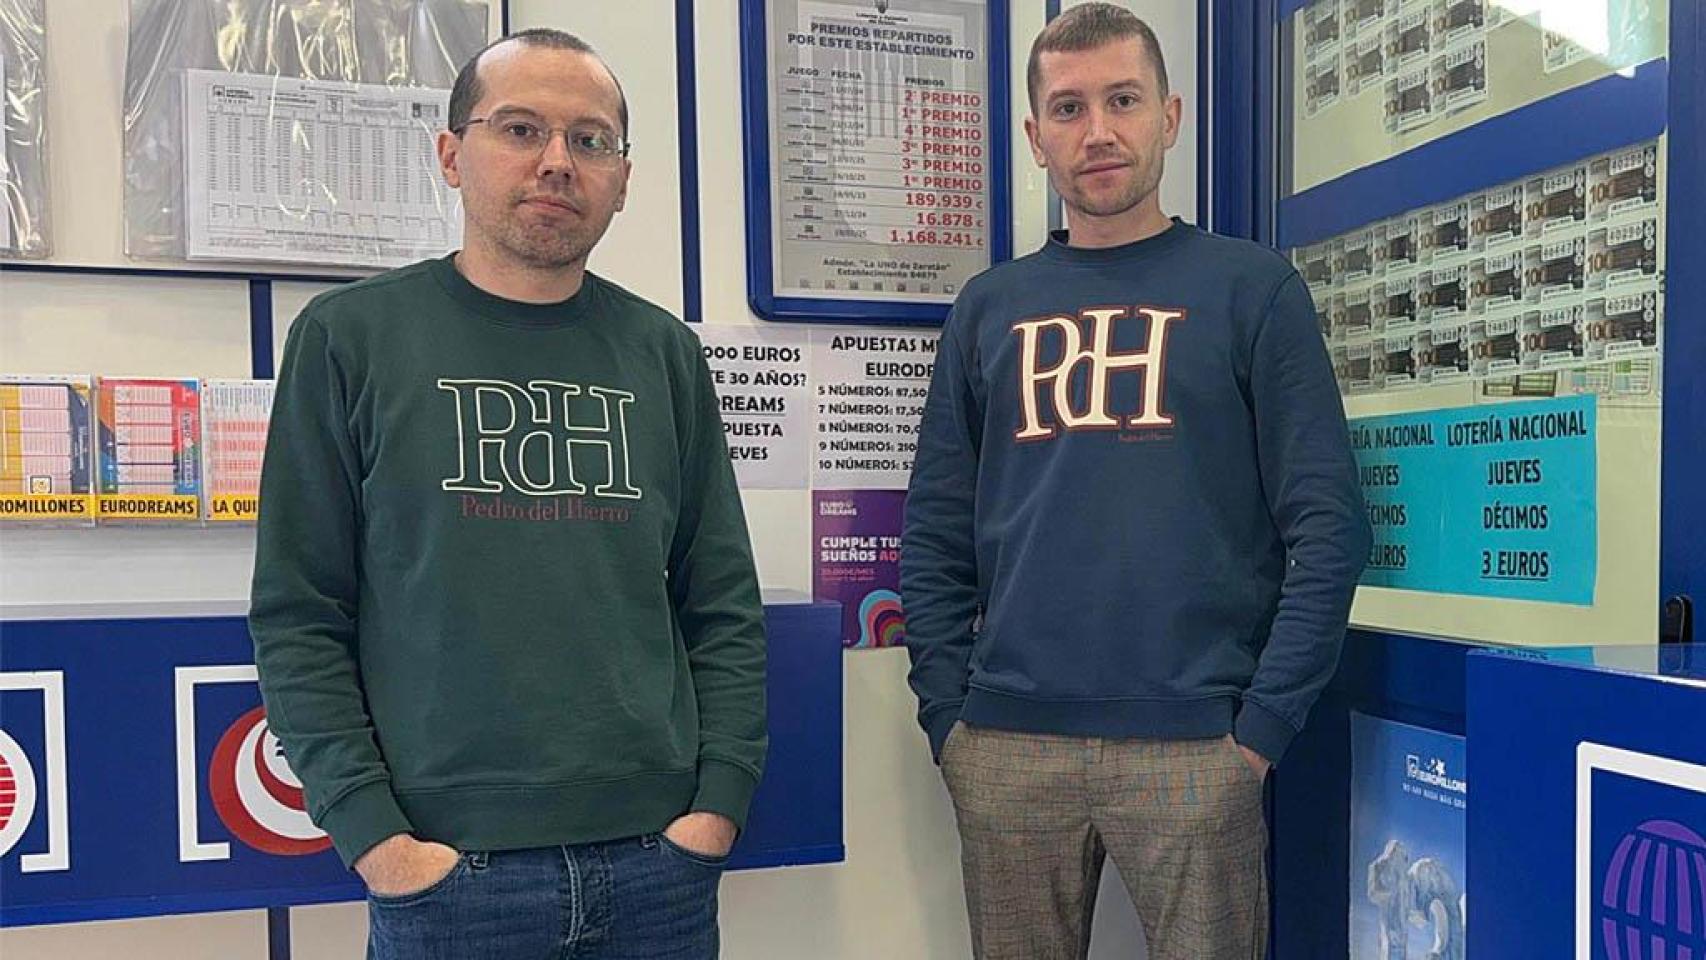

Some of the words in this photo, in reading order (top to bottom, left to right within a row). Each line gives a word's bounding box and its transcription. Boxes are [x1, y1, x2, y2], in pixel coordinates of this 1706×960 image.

[810, 22, 869, 38] PREMIOS
[872, 29, 953, 45] REPARTIDOS
[787, 33, 816, 46] POR
[819, 37, 852, 49] ESTE
[856, 40, 974, 60] ESTABLECIMIENTO
[787, 67, 819, 76] JUEGO
[831, 70, 862, 80] FECHA
[905, 78, 945, 87] PREMIOS
[922, 91, 981, 107] PREMIO
[922, 108, 981, 124] PREMIO
[922, 126, 982, 141] PREMIO
[922, 142, 982, 158] PREMIO
[923, 160, 983, 174] PREMIO
[923, 176, 983, 190] PREMIO
[906, 192, 972, 208] 189.939
[917, 212, 973, 227] 16.878
[890, 229, 972, 245] 1.168.241
[831, 335, 917, 352] APUESTAS
[743, 346, 801, 362] EUROS
[729, 372, 749, 385] 30
[753, 369, 807, 387] AÑOS?
[817, 386, 825, 396] 5
[828, 382, 894, 397] NÚMEROS:
[722, 395, 785, 413] REAMS
[817, 404, 826, 414] 7
[828, 401, 894, 415] NÚMEROS:
[818, 423, 826, 432] 8
[829, 420, 894, 434] NÚMEROS:
[1375, 422, 1435, 448] NACIONAL
[1447, 414, 1504, 447] LOTERÍA
[1509, 410, 1588, 442] NACIONAL
[437, 378, 643, 499] PdH
[818, 441, 827, 451] 9
[830, 437, 895, 452] NÚMEROS:
[730, 446, 769, 460] EVES
[819, 459, 832, 469] 10
[835, 456, 900, 471] NÚMEROS:
[1360, 464, 1400, 486] JUEVES
[1487, 459, 1542, 486] JUEVES
[101, 500, 194, 515] EURODREAMS
[213, 500, 229, 513] LA
[233, 500, 257, 516] QUI
[460, 494, 525, 518] Pedro
[530, 497, 560, 521] del
[567, 496, 630, 522] Hierro
[1483, 500, 1549, 530] DÉCIMOS
[821, 536, 878, 548] CUMPLE
[821, 548, 877, 562] SUEÑOS
[880, 550, 901, 563] AQ
[1481, 551, 1492, 576] 3
[1497, 551, 1549, 577] EUROS
